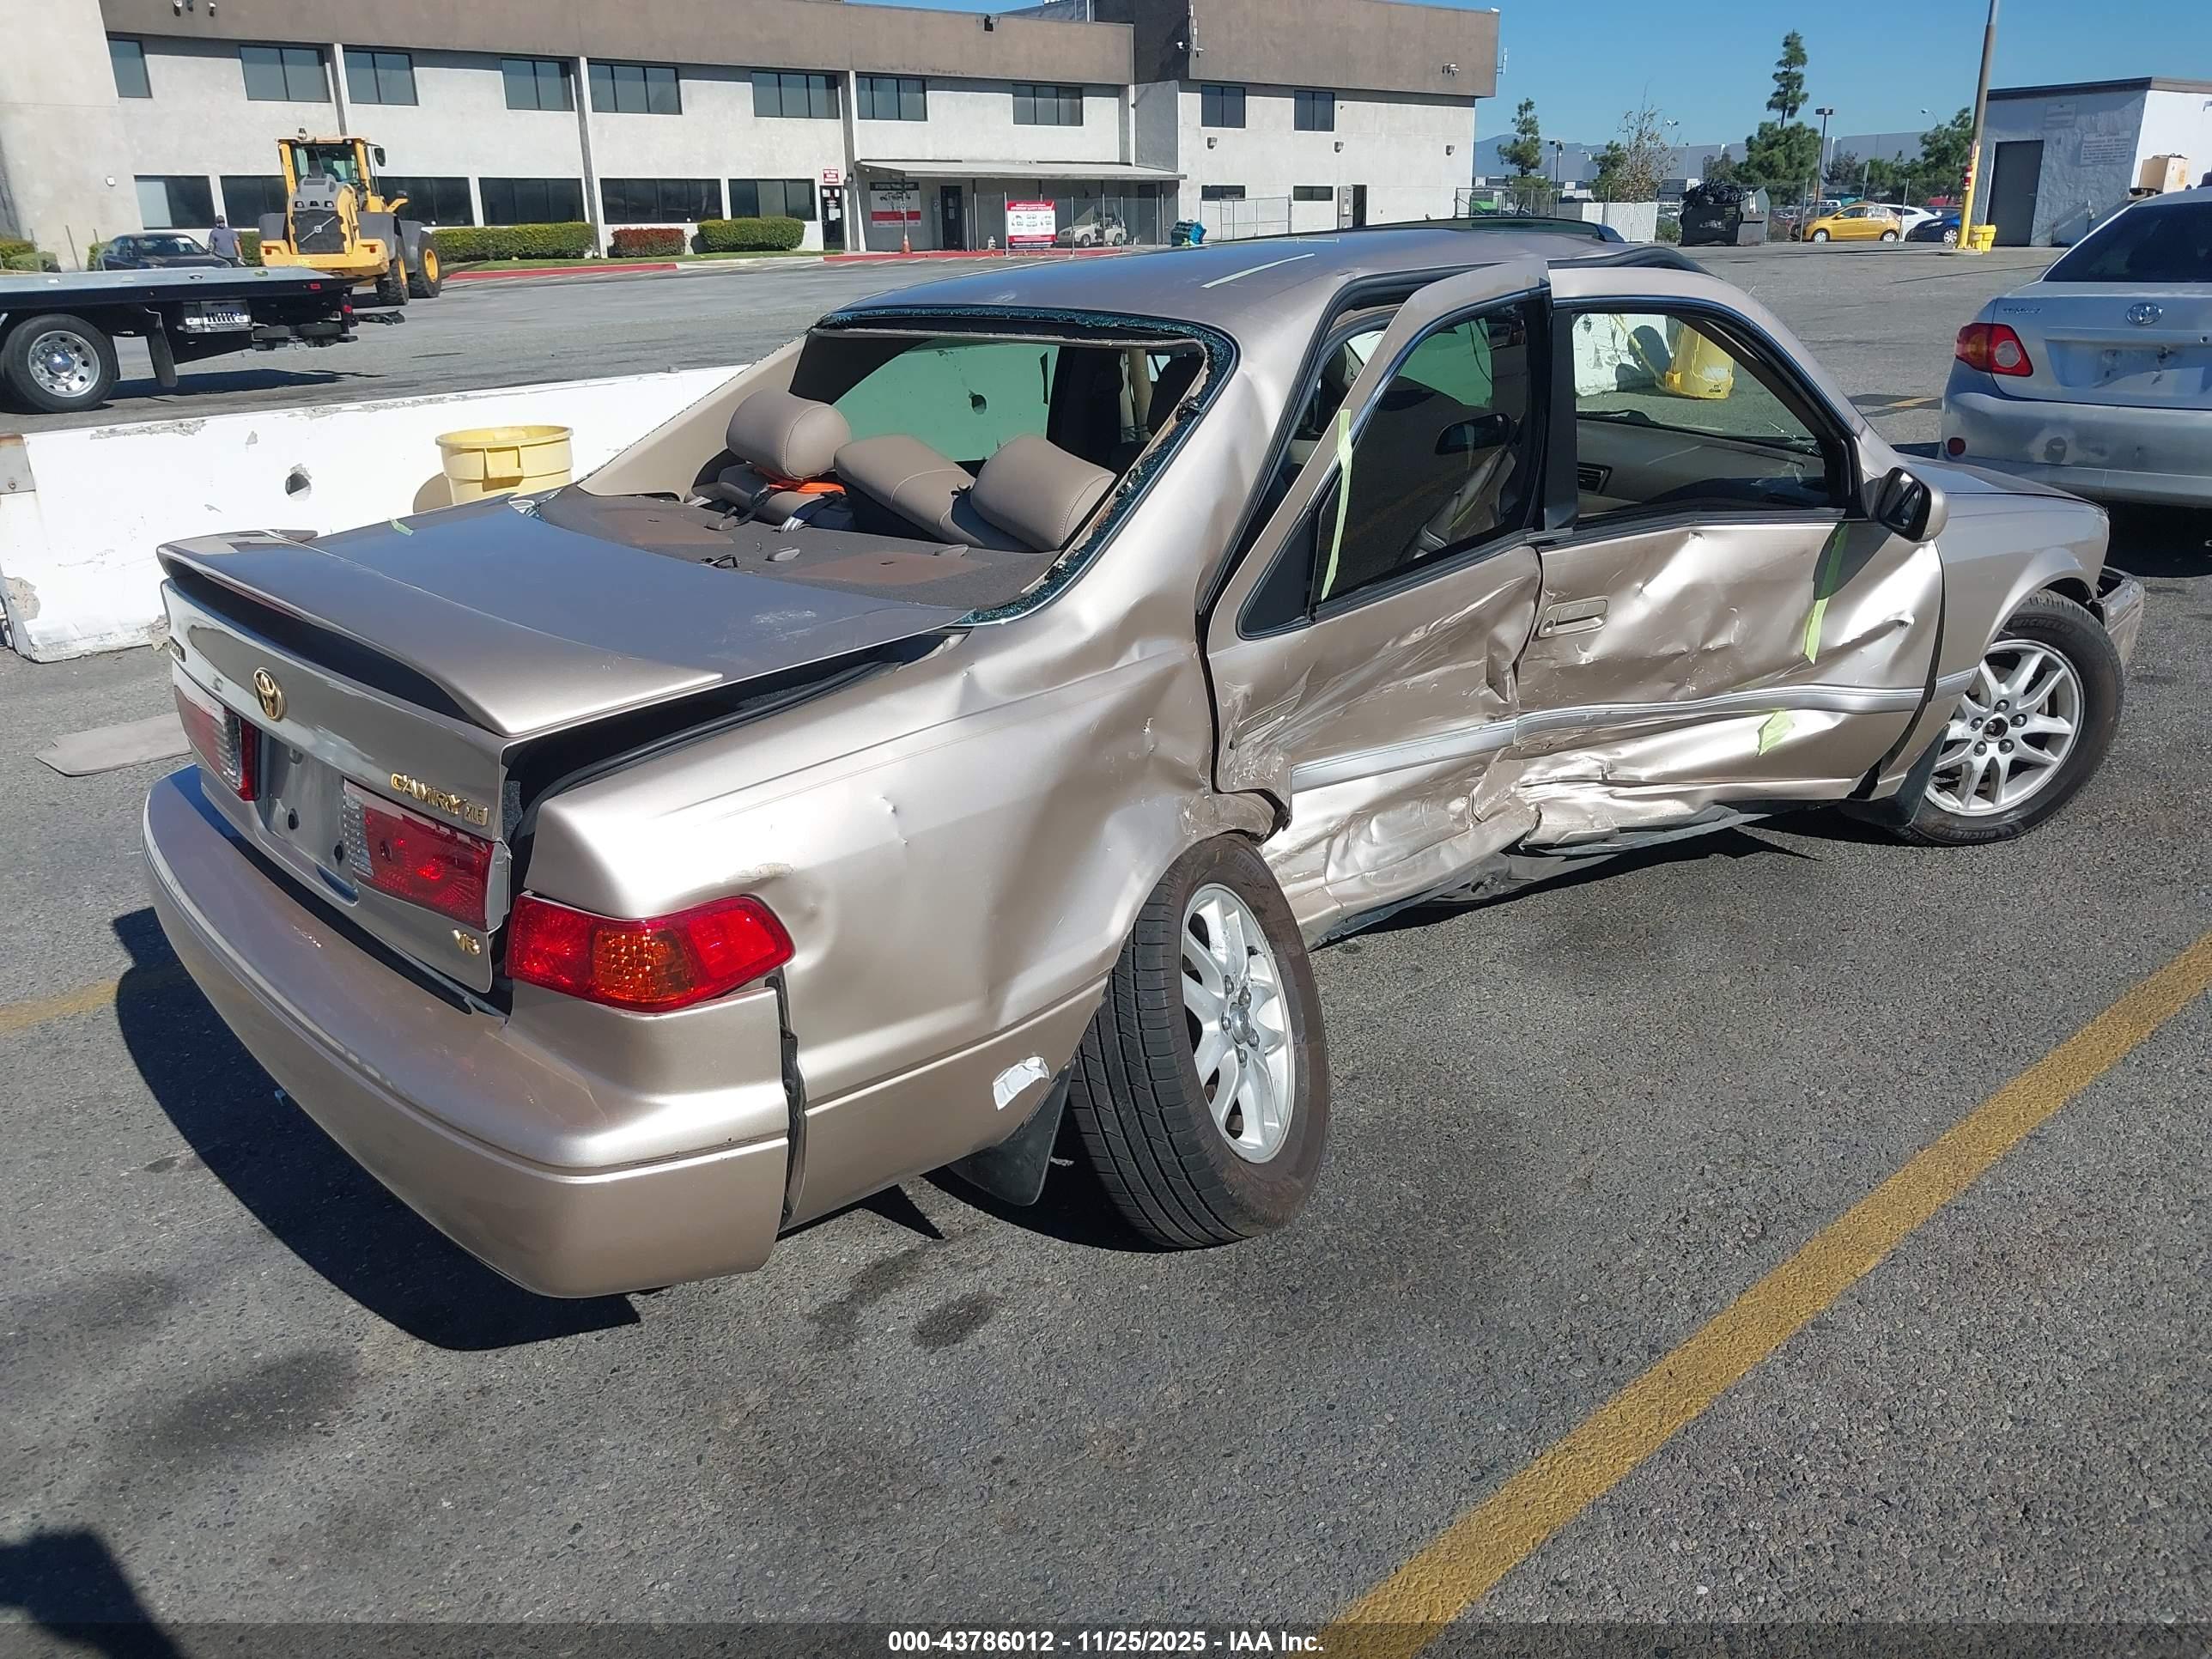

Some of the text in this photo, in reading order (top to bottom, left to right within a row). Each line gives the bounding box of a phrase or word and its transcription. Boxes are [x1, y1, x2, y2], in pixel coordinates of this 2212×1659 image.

[392, 773, 486, 824] CAMRY XLE
[452, 929, 481, 956] V6
